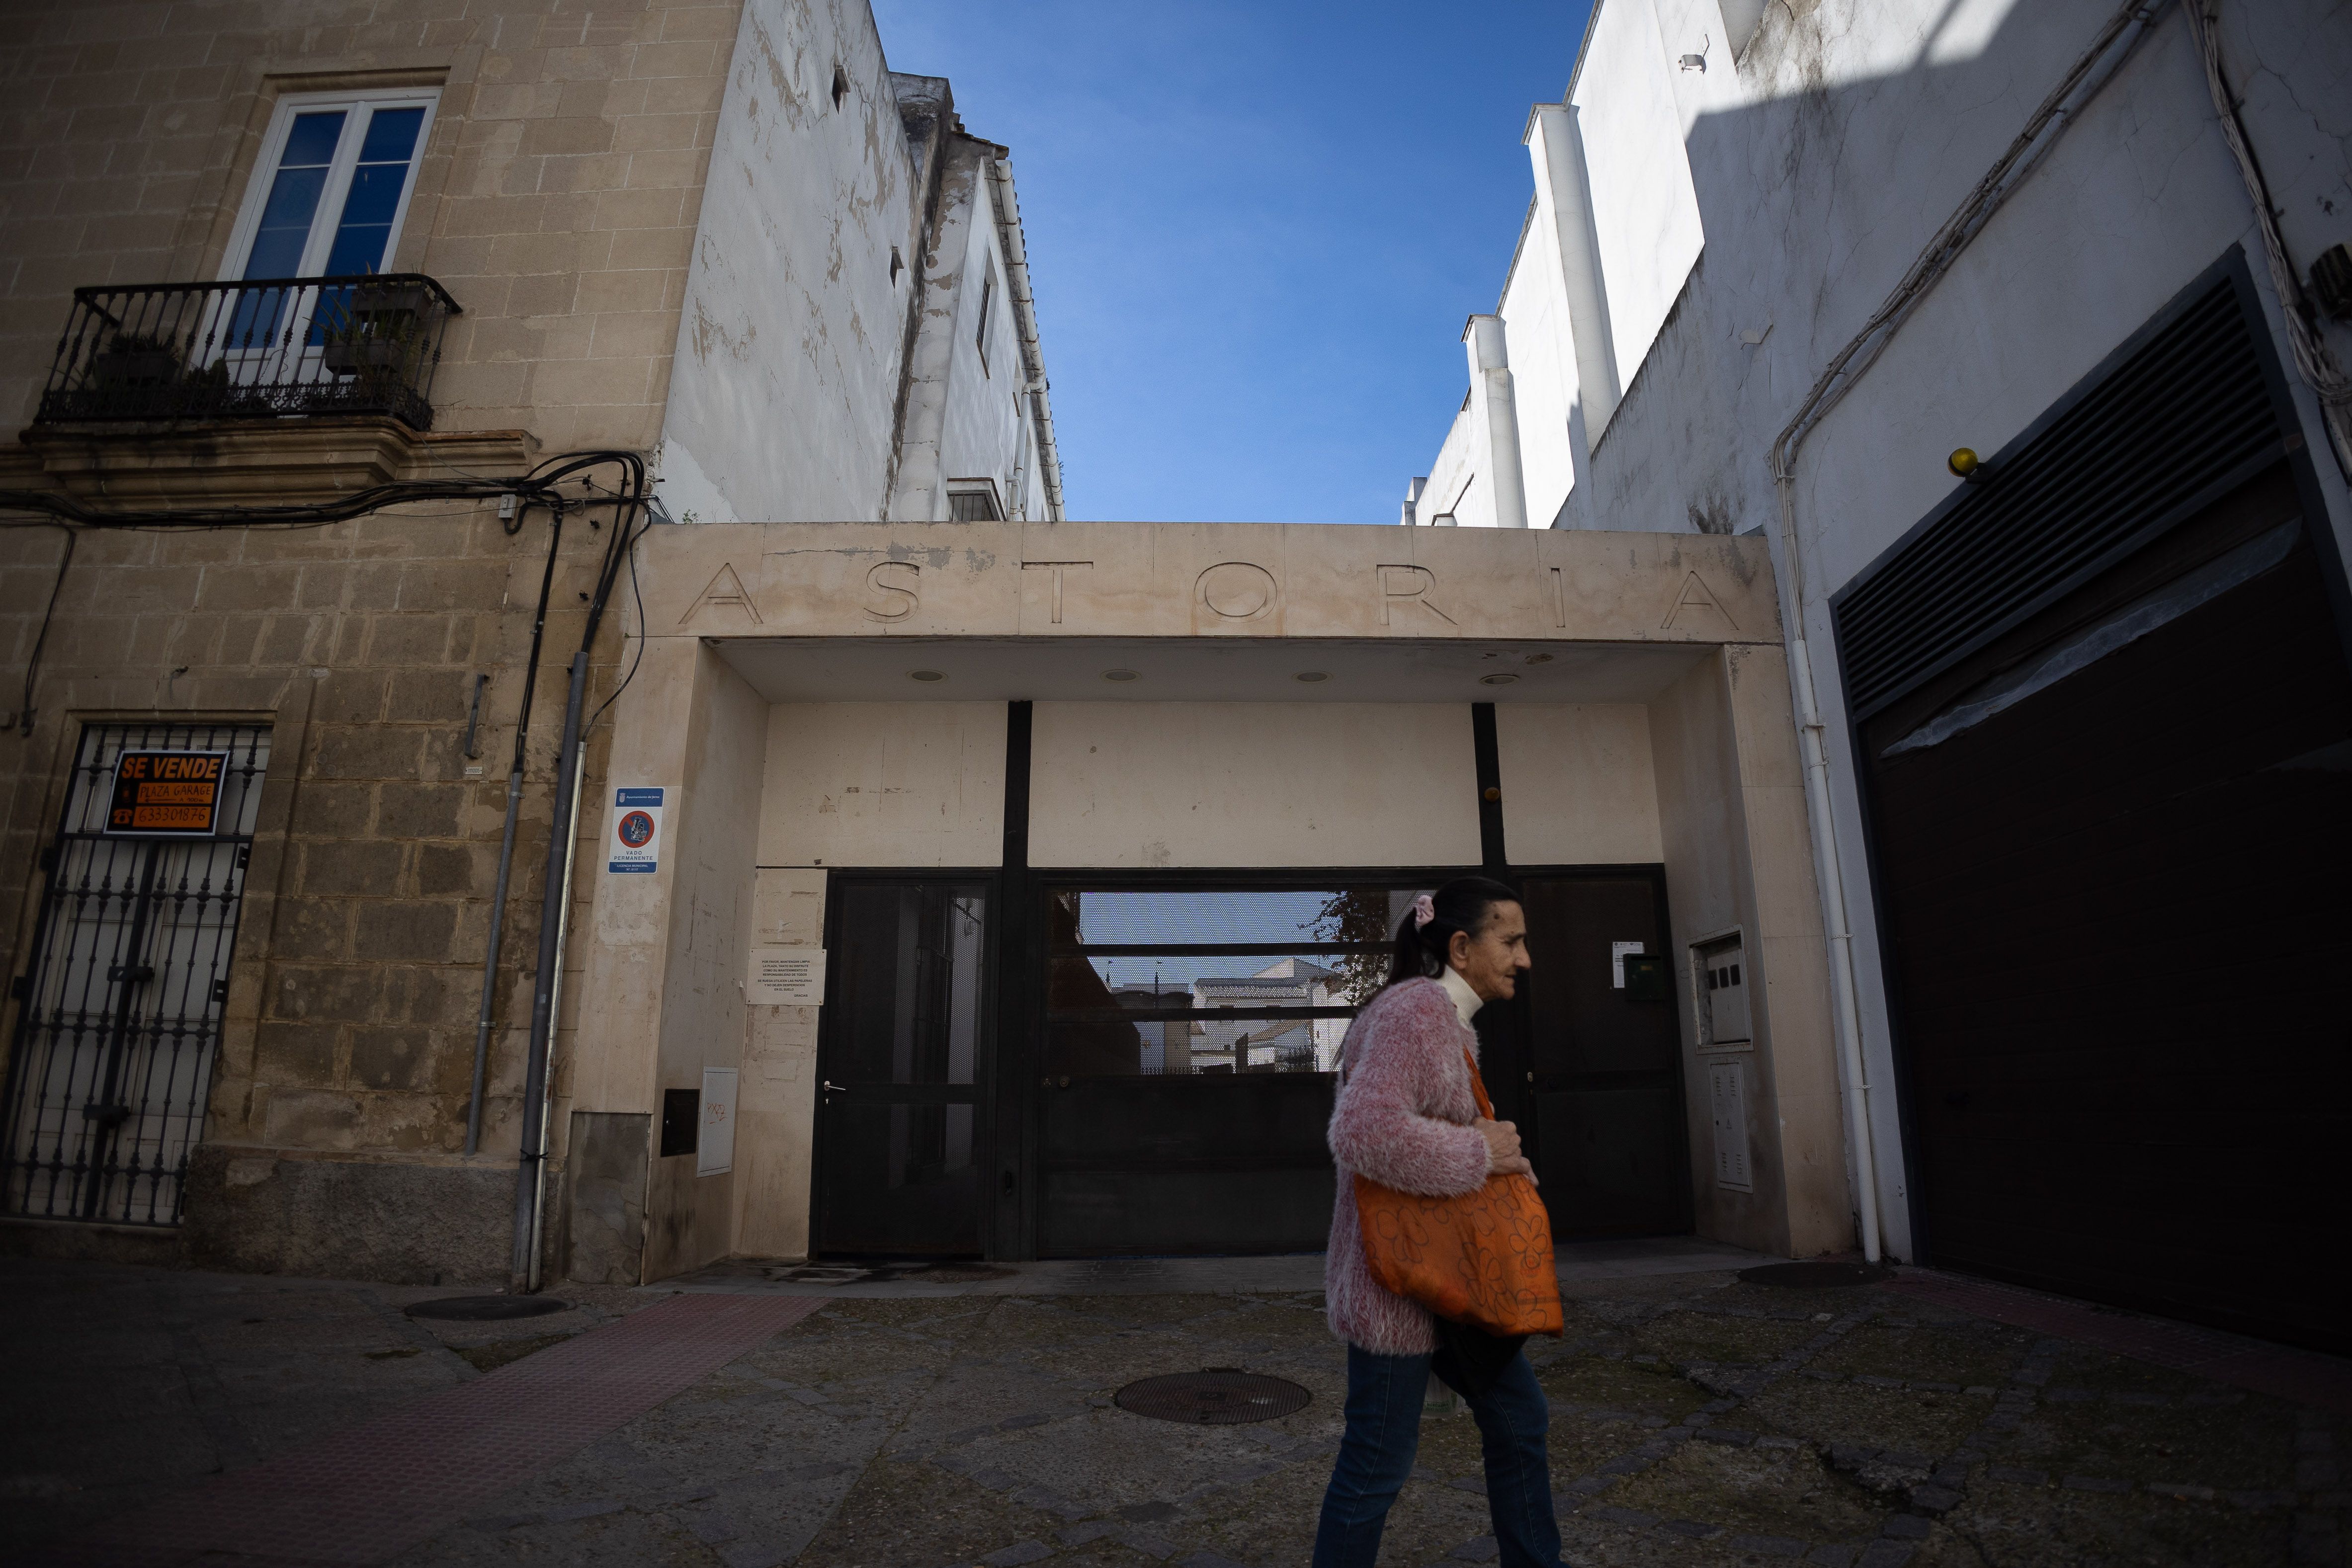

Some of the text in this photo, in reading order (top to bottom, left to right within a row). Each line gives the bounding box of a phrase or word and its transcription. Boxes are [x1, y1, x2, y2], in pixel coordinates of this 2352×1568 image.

[678, 561, 1740, 630] ASTORIA
[122, 757, 222, 778] SE VENDE
[140, 785, 211, 798] PLAZA GARAGE
